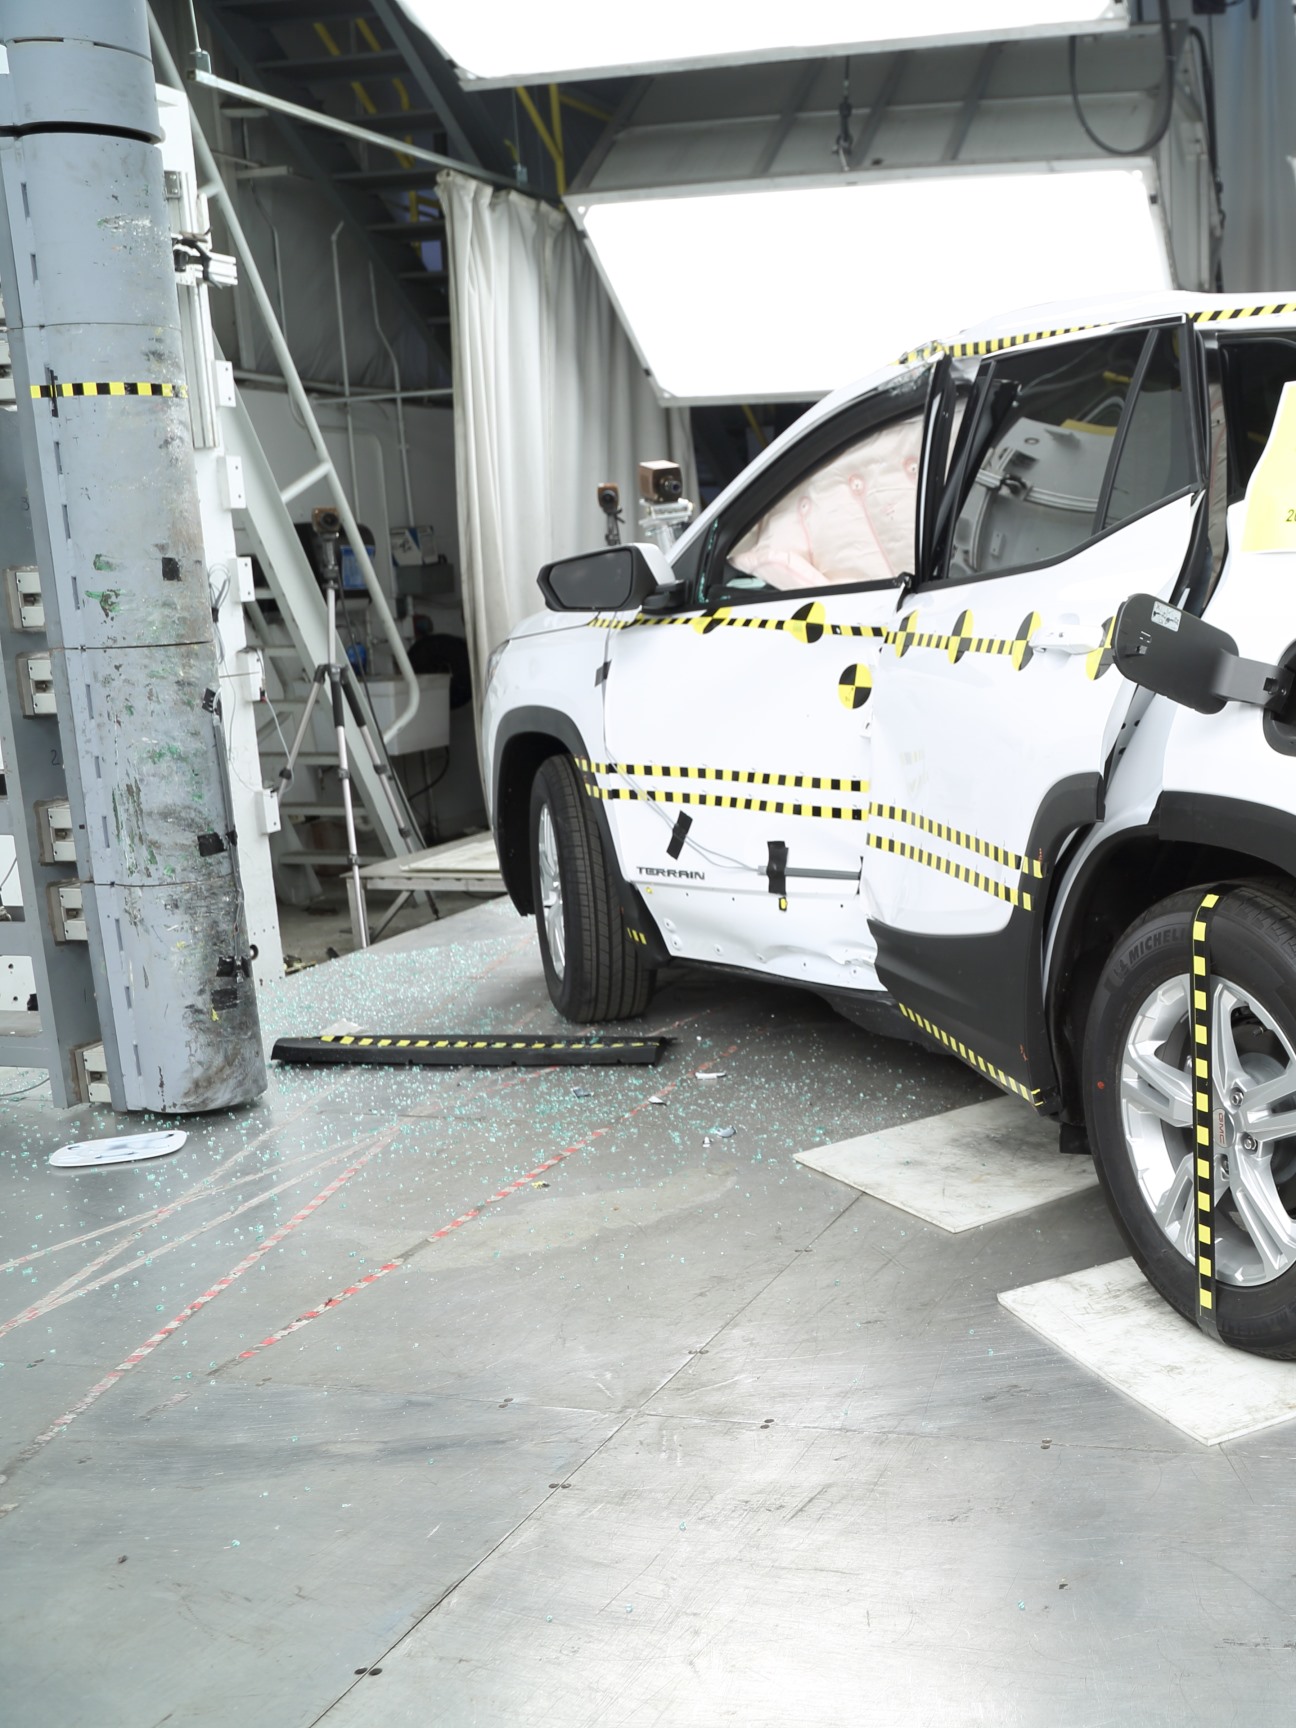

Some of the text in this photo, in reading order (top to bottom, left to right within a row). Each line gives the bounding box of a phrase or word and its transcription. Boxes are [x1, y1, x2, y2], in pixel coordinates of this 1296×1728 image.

[636, 866, 705, 880] TERRAIN
[1128, 927, 1188, 964] MICHELI
[1218, 1112, 1226, 1145] GMC
